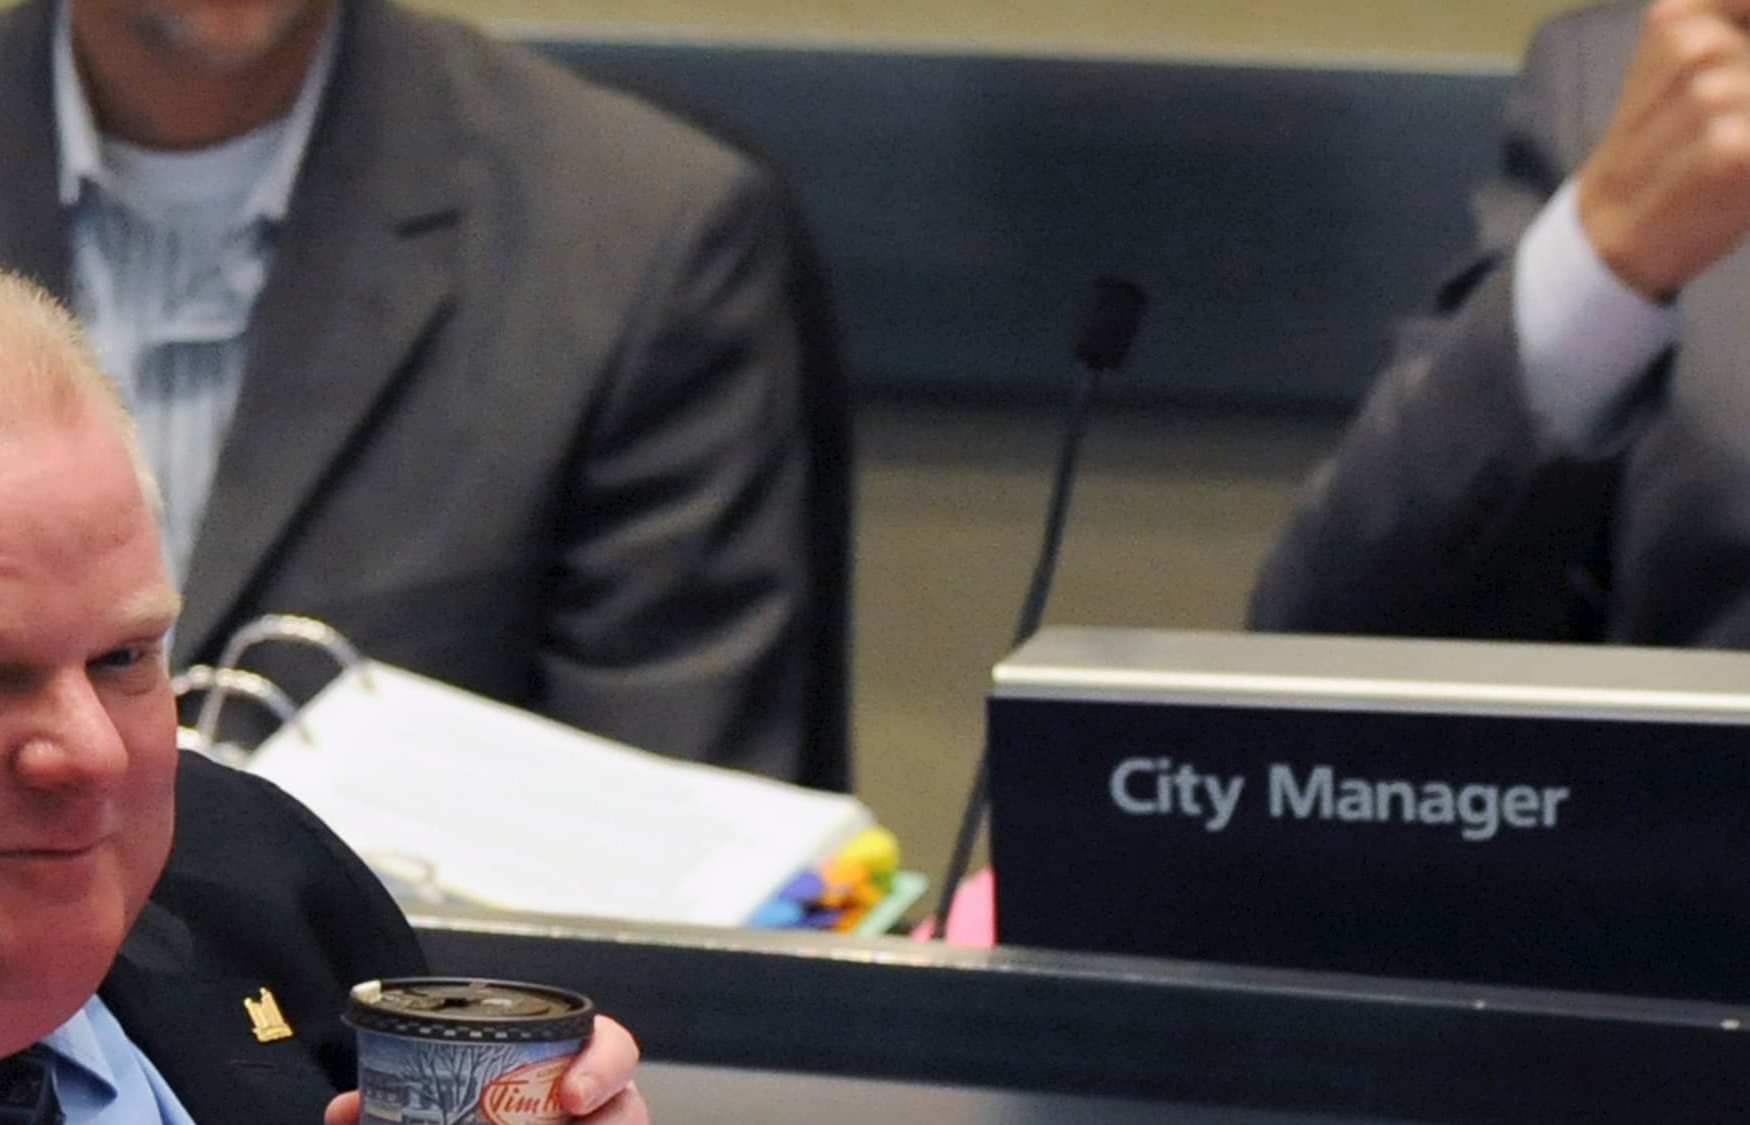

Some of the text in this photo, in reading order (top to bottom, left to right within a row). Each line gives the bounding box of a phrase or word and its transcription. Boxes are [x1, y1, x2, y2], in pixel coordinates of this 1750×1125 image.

[1110, 757, 1570, 841] City Manager
[489, 1079, 541, 1114] Tim
